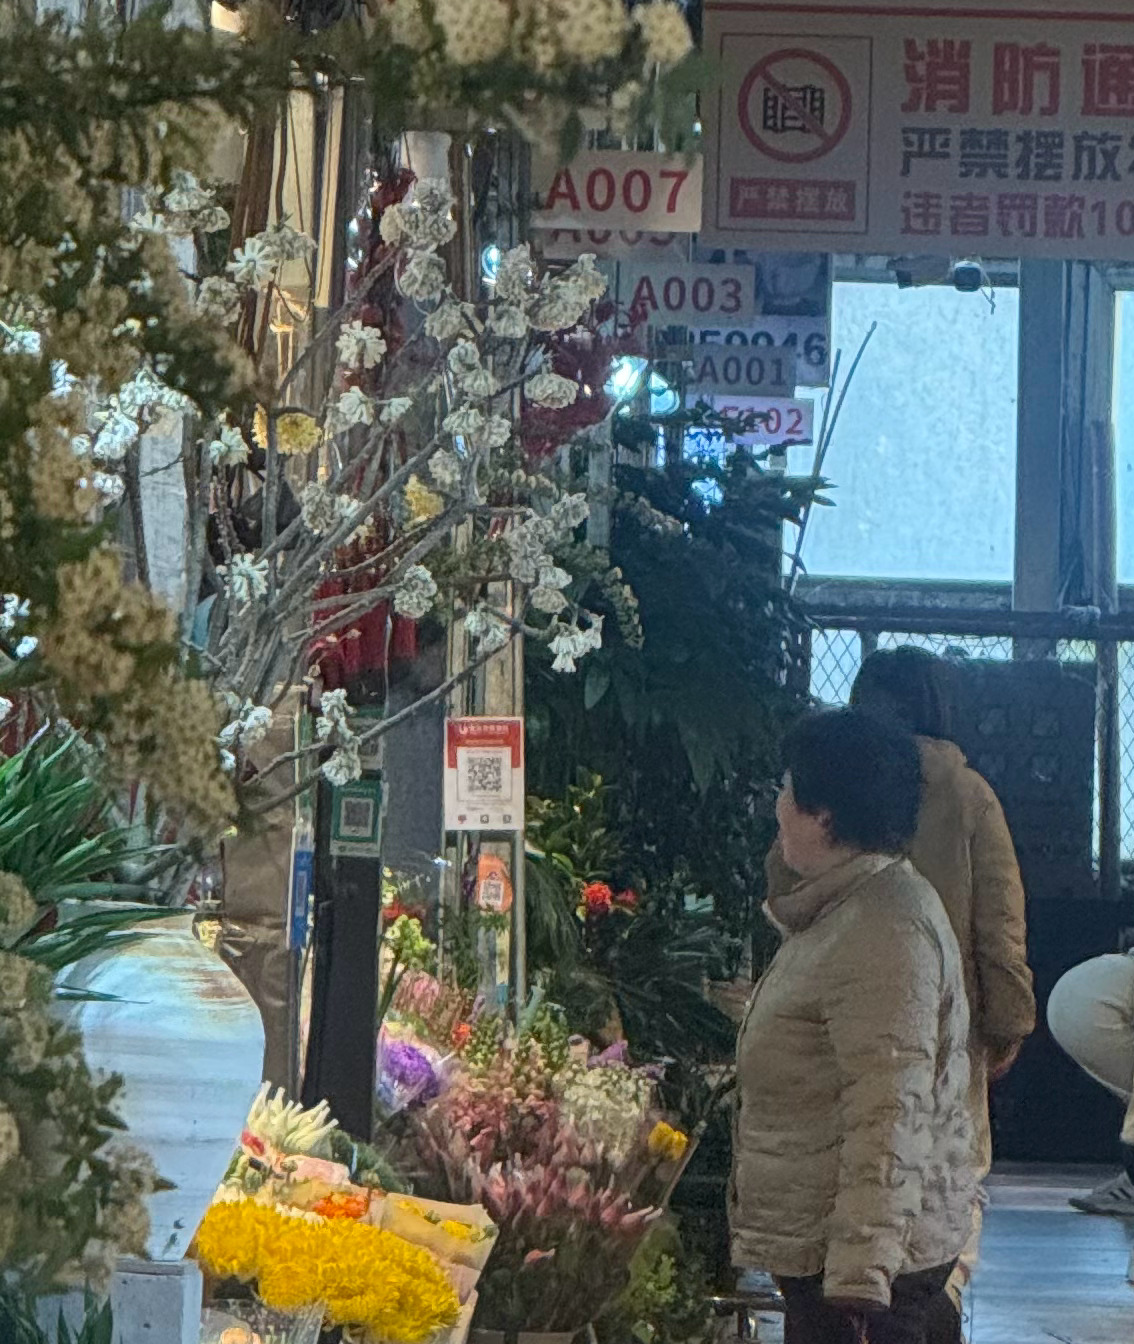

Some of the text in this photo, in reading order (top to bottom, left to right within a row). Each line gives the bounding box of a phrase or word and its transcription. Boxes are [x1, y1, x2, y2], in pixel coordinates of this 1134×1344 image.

[544, 167, 689, 214] A007
[631, 274, 743, 314] A003
[698, 355, 788, 386] A001
